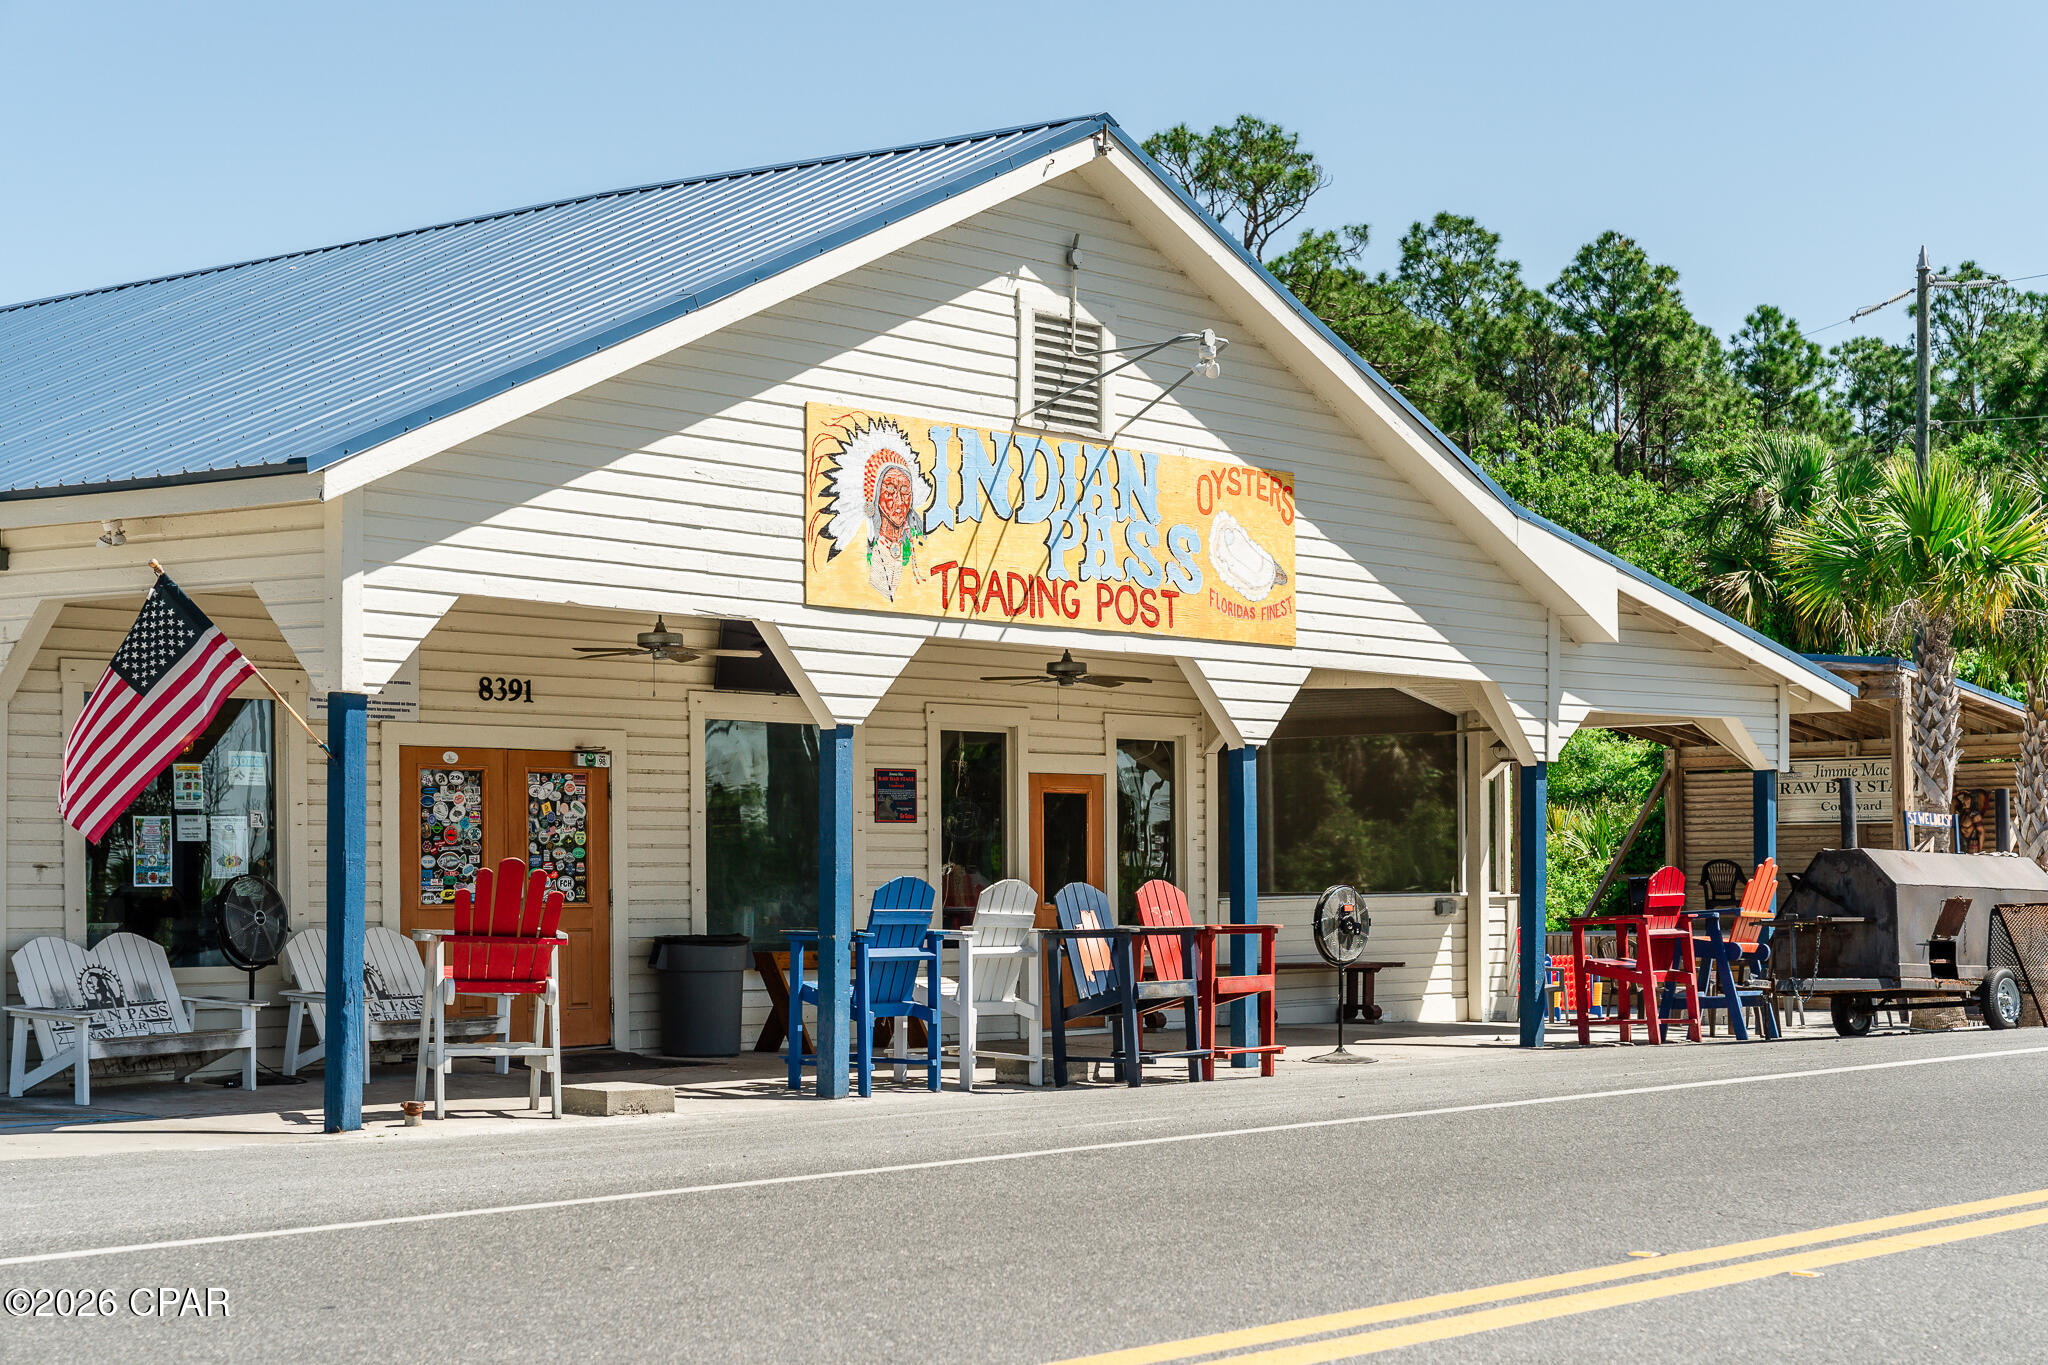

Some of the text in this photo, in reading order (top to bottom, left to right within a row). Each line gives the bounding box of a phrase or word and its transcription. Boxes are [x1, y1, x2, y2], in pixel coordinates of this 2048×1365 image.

[923, 425, 1162, 536] INDIAN
[1196, 466, 1295, 526] OYSTERS
[1044, 509, 1204, 595] PASS
[930, 560, 1180, 629] TRADING POST
[1209, 587, 1293, 622] FLORIDAS FINEST
[478, 676, 534, 703] 8391
[1813, 763, 1859, 779] Jimmie
[1779, 781, 1819, 795] RAW
[119, 1022, 147, 1032] BAR
[126, 1004, 170, 1020] PASS
